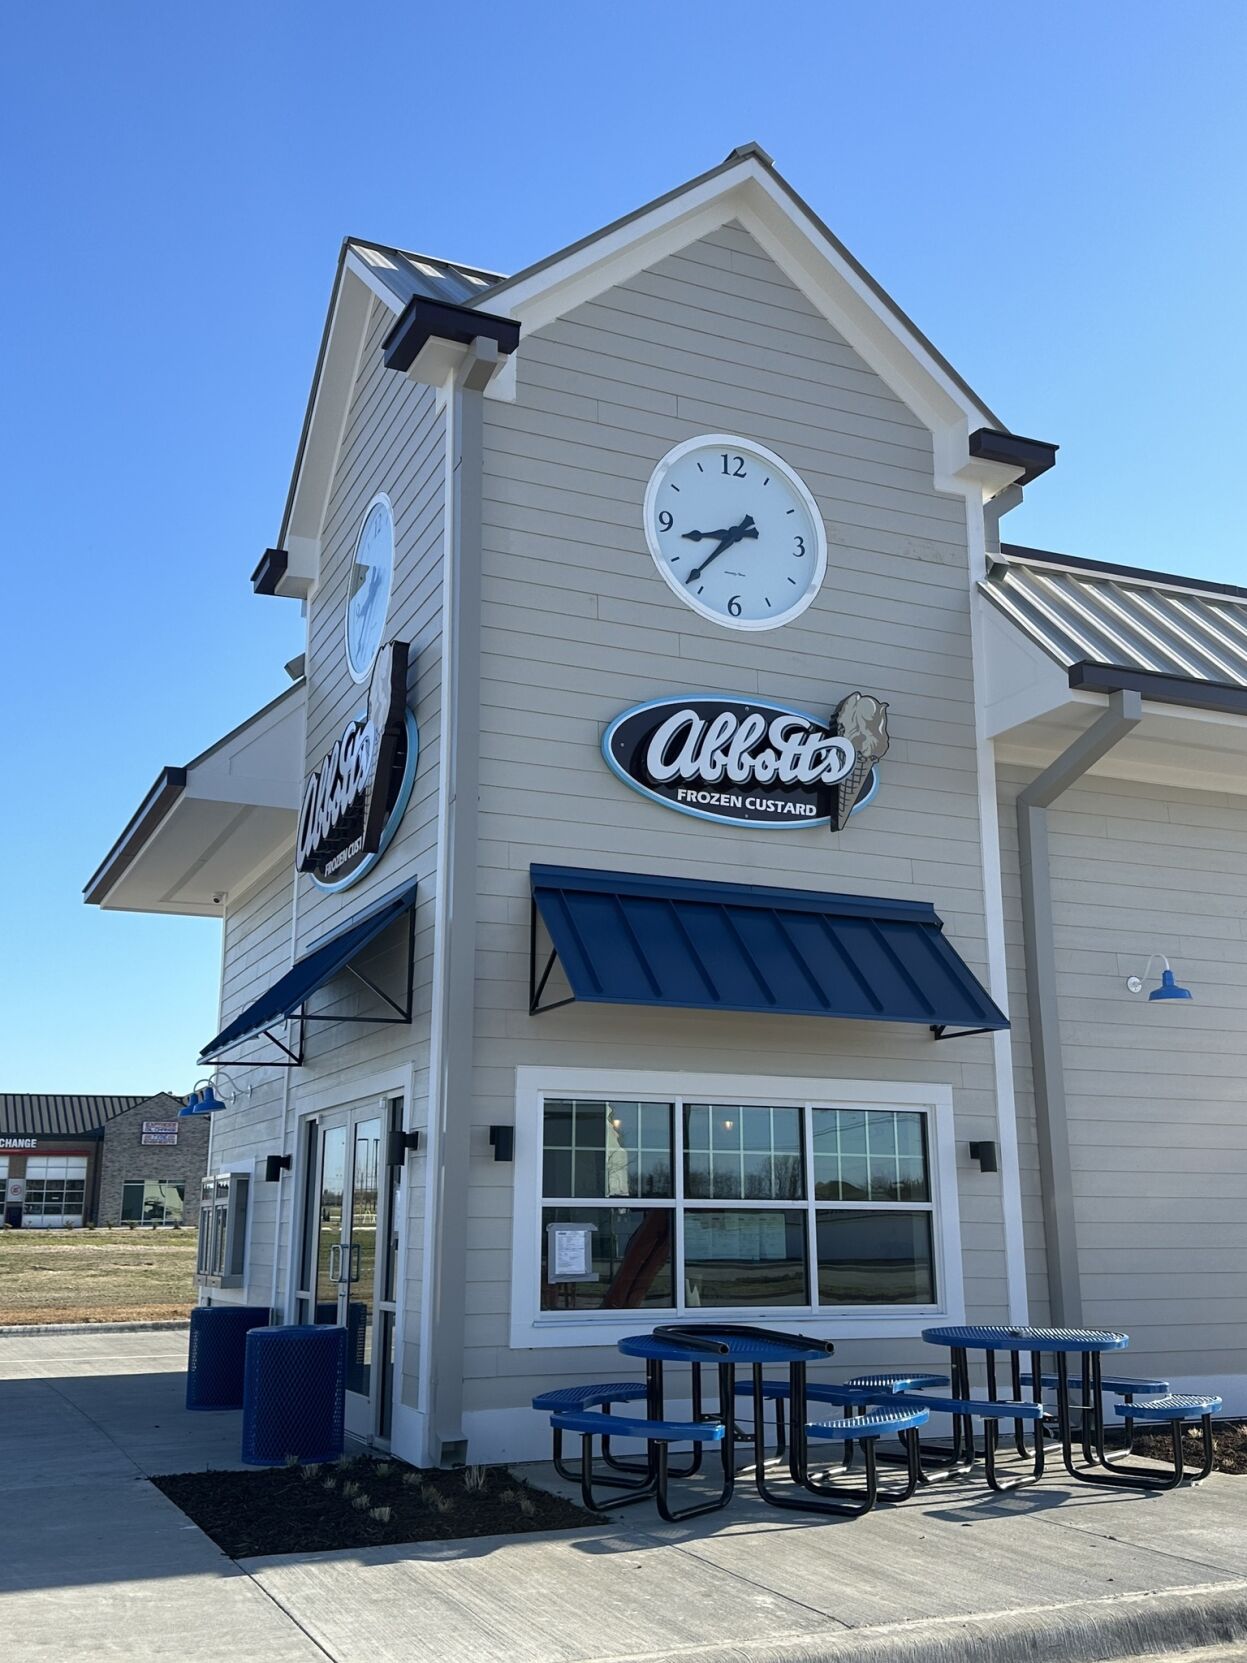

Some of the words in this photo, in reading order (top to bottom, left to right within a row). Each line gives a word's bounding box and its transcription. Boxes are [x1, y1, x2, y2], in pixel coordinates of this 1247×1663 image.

[720, 453, 747, 478] 12
[658, 510, 674, 532] 9
[792, 535, 806, 557] 3
[727, 595, 742, 617] 6
[677, 788, 742, 808] FROZEN
[745, 797, 817, 816] CUSTARD
[324, 847, 348, 878] FROZEN
[348, 835, 362, 859] CUST
[0, 1138, 37, 1148] CHANGE
